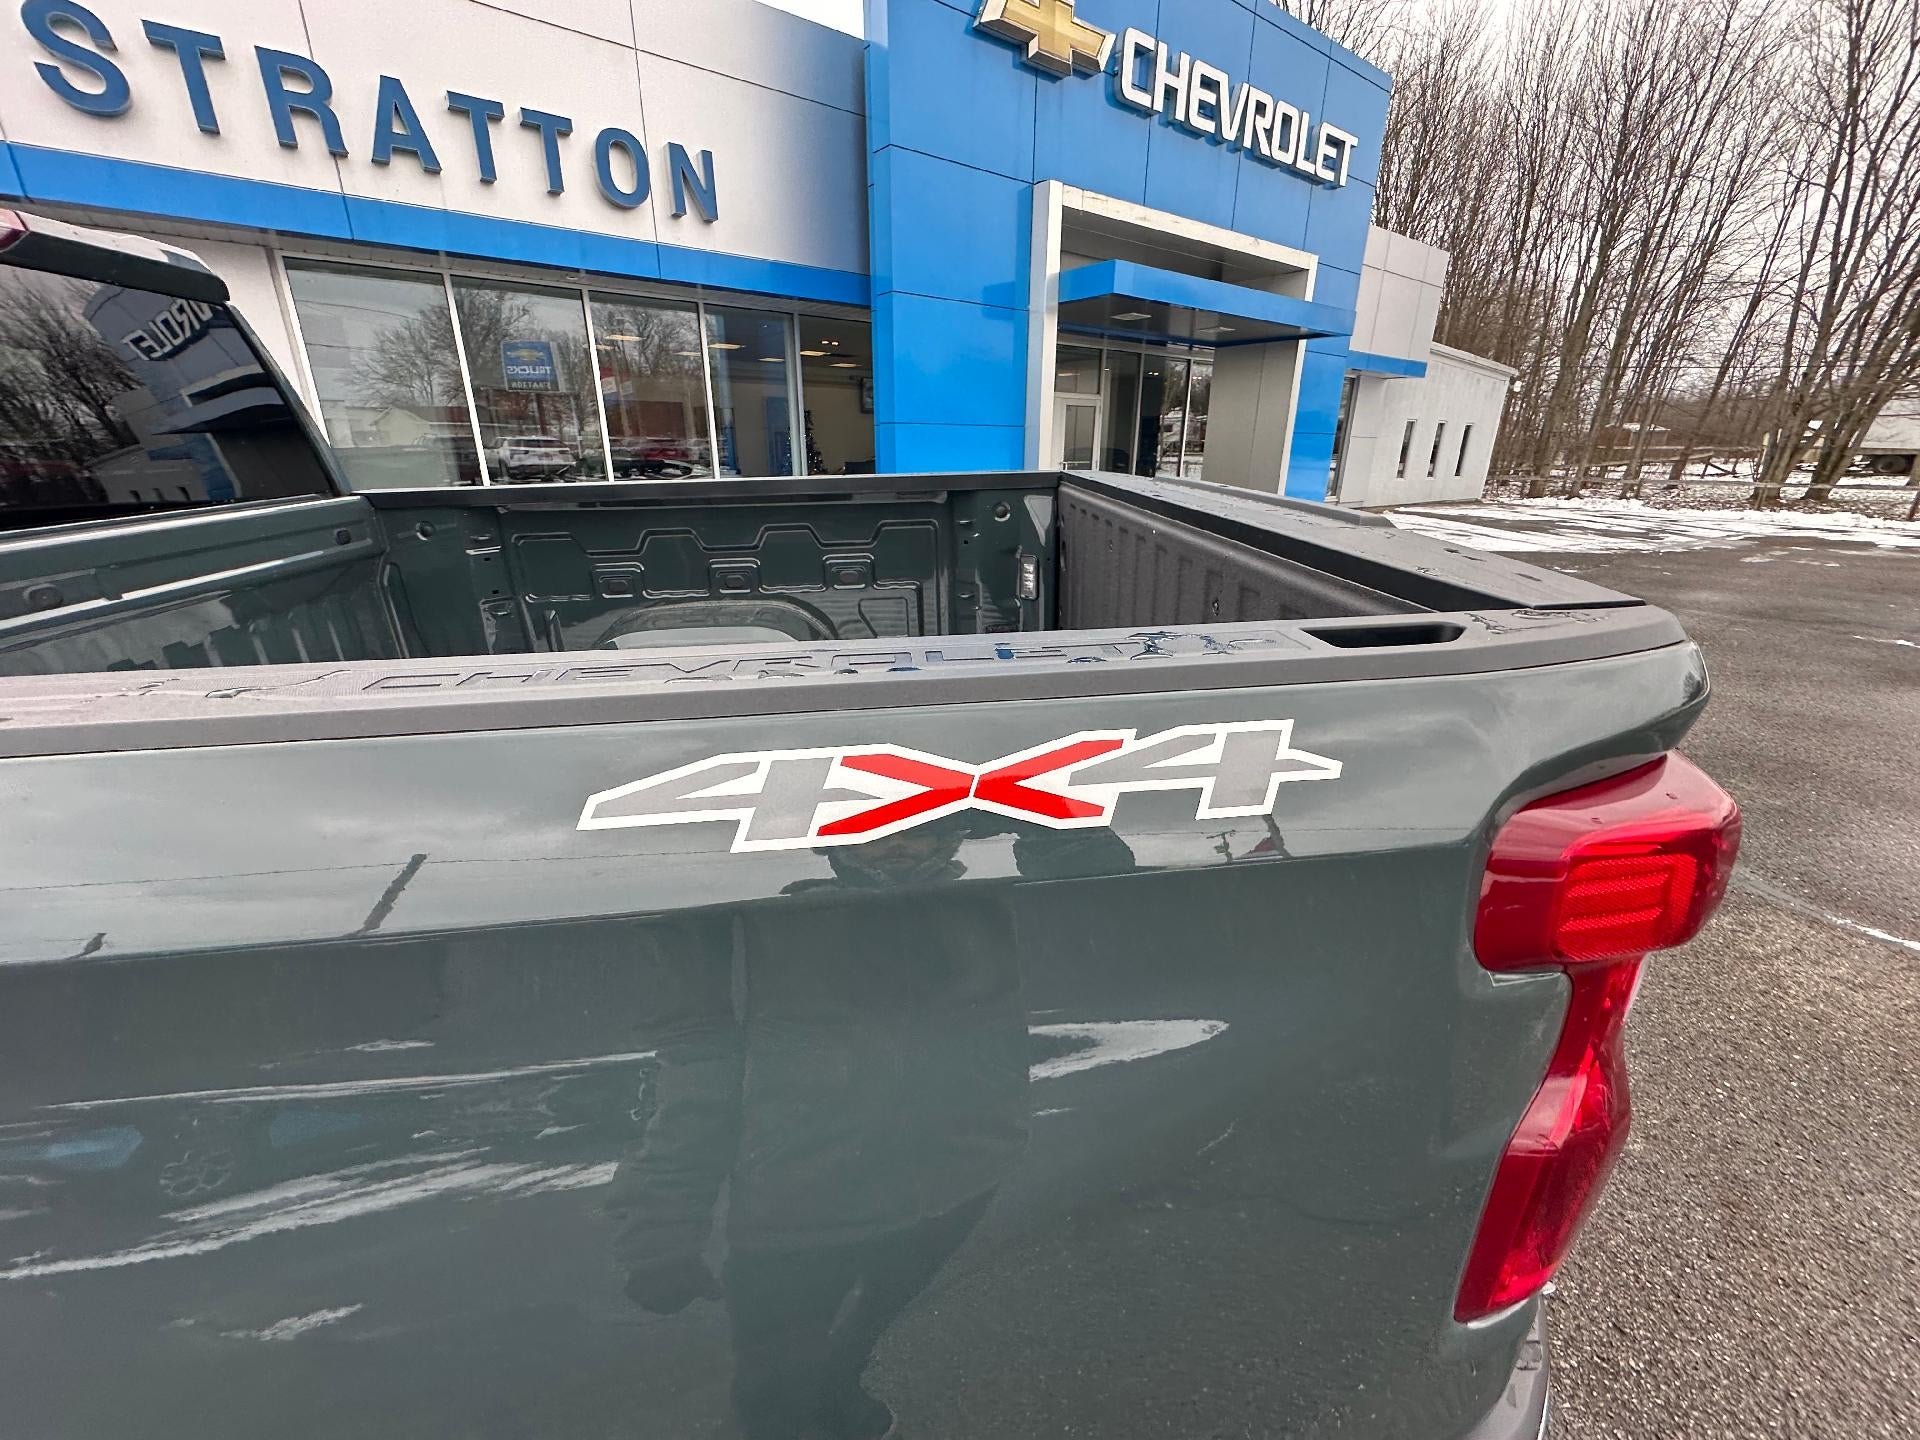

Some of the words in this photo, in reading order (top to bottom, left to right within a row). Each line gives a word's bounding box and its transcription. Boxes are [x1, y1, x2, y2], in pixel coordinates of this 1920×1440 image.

[21, 0, 719, 224] STRATTON
[1120, 27, 1359, 188] CHEVROLET
[362, 640, 1143, 692] CHEVROLET
